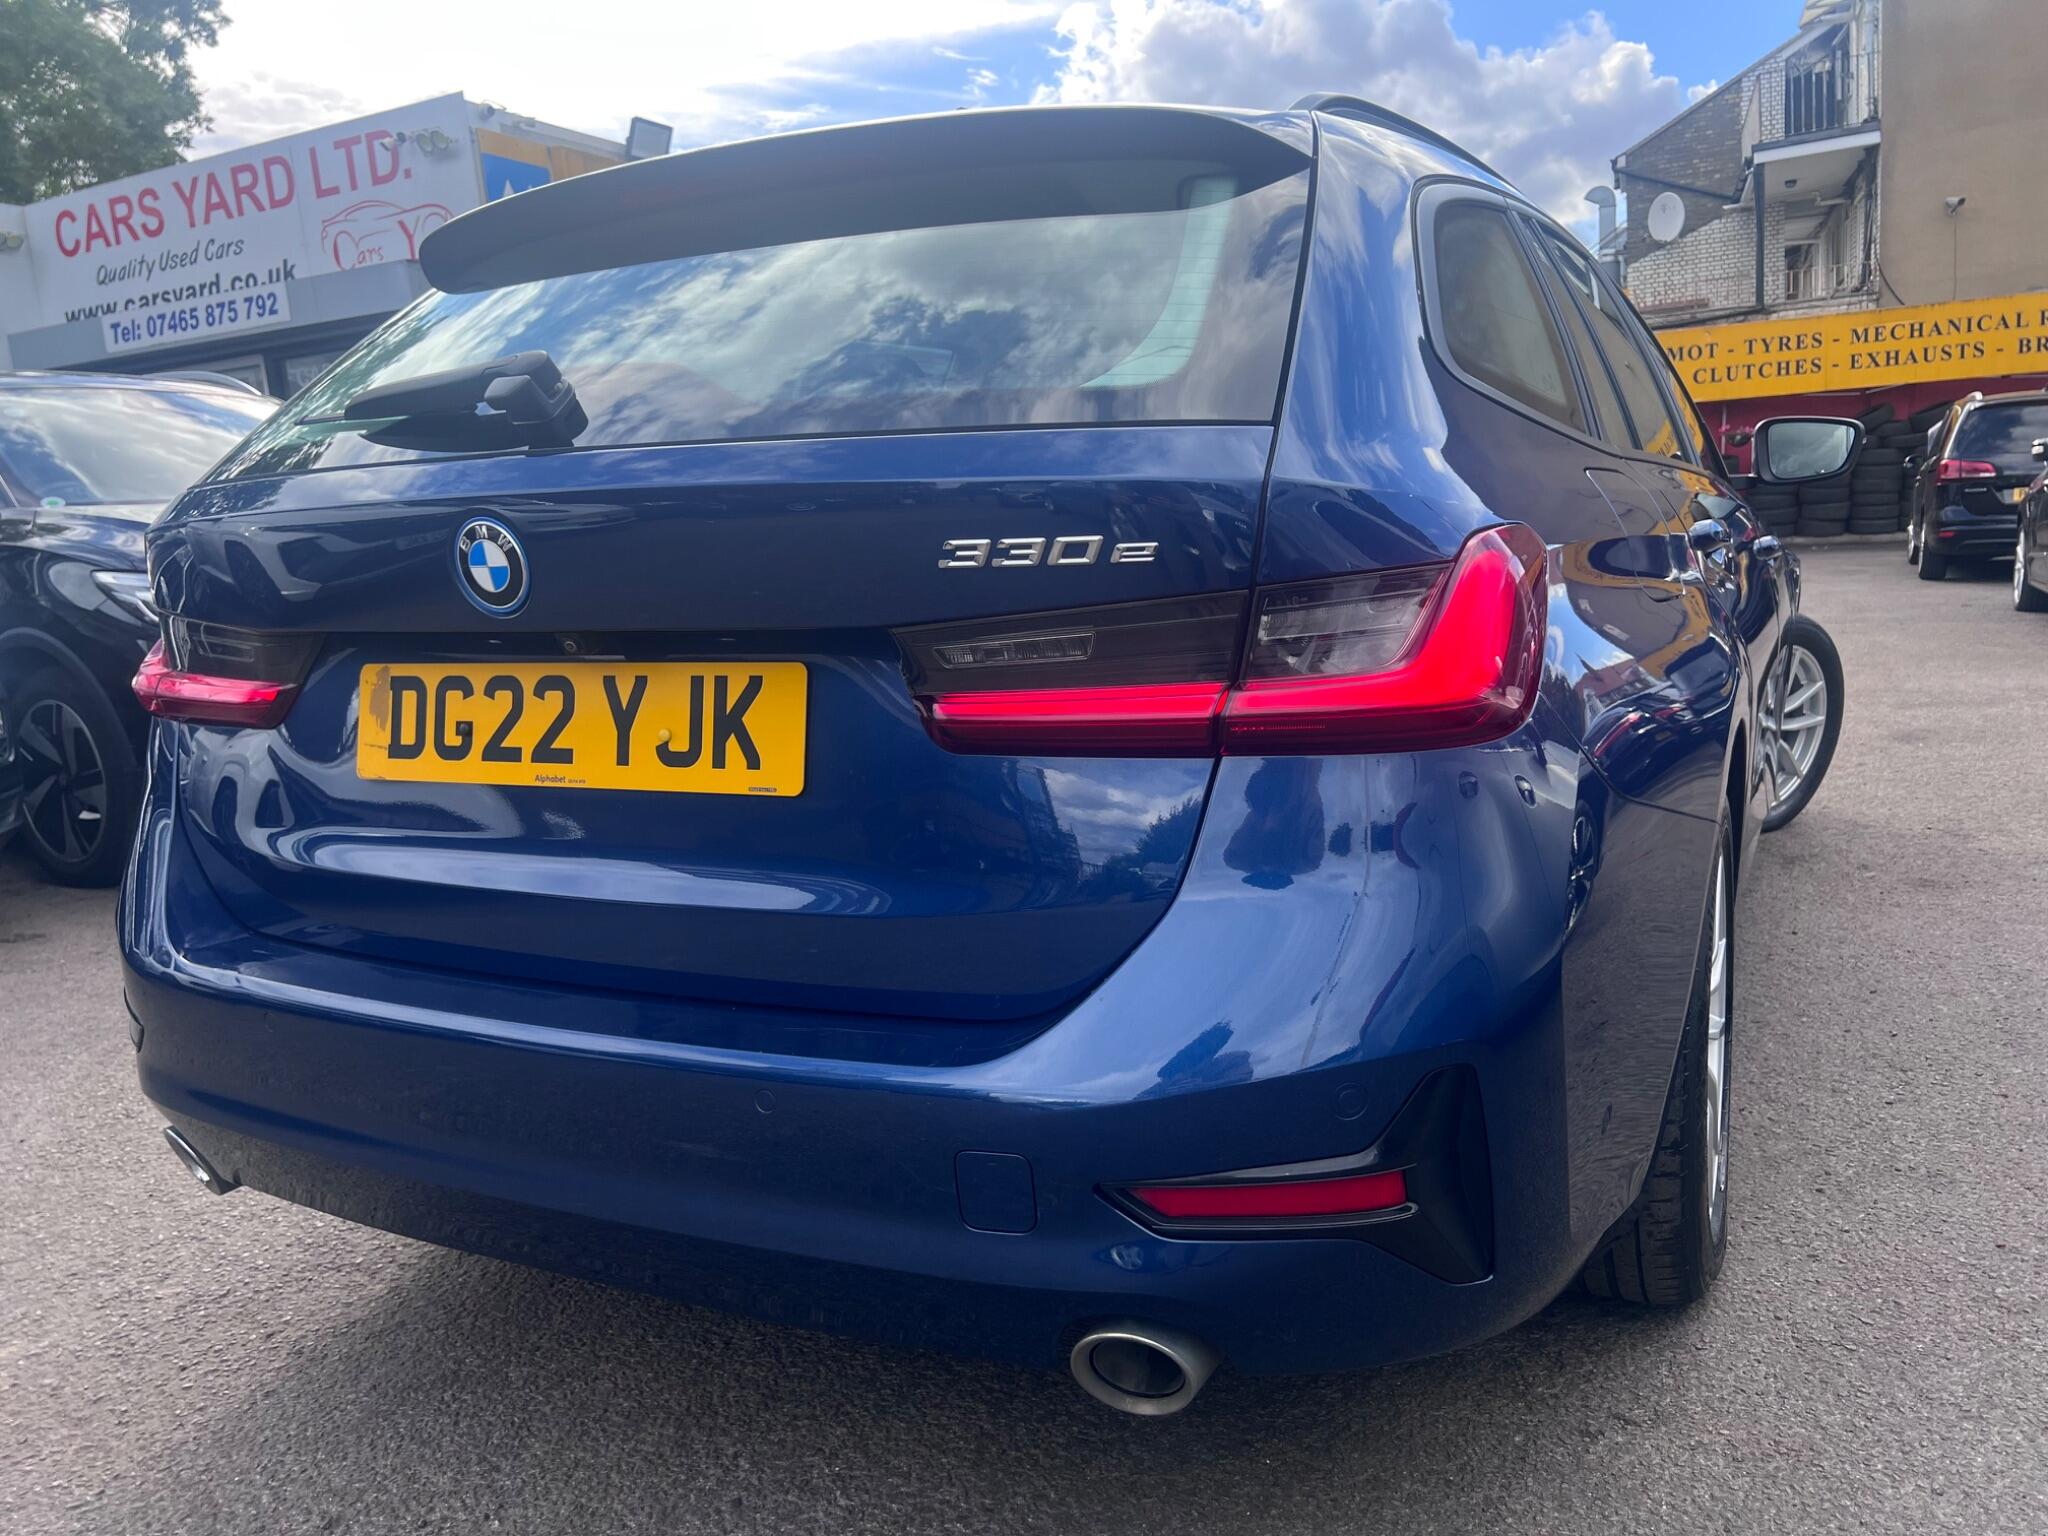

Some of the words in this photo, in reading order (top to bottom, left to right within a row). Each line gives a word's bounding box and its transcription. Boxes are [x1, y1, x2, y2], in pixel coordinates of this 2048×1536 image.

[55, 187, 165, 258] CARS
[172, 155, 296, 229] YARD
[309, 129, 412, 199] LTD.
[96, 254, 156, 285] Quality
[159, 240, 201, 272] Used
[204, 238, 245, 262] Cars
[65, 258, 297, 323] wwwcarsyard.co.uk
[110, 319, 142, 345] Tel:
[146, 307, 200, 338] 07465
[205, 299, 238, 327] 875
[243, 291, 279, 318] 792
[1666, 342, 1720, 363] MOT
[1744, 332, 1823, 355] TYRES
[1850, 311, 2030, 345] MECHANICAL
[1692, 357, 1823, 385] CLUTCHES
[1849, 340, 1985, 370] EXHAUSTS
[460, 525, 513, 554] BMW
[387, 675, 576, 765] DG22
[602, 675, 764, 771] YJK
[534, 773, 567, 784] Alphabet
